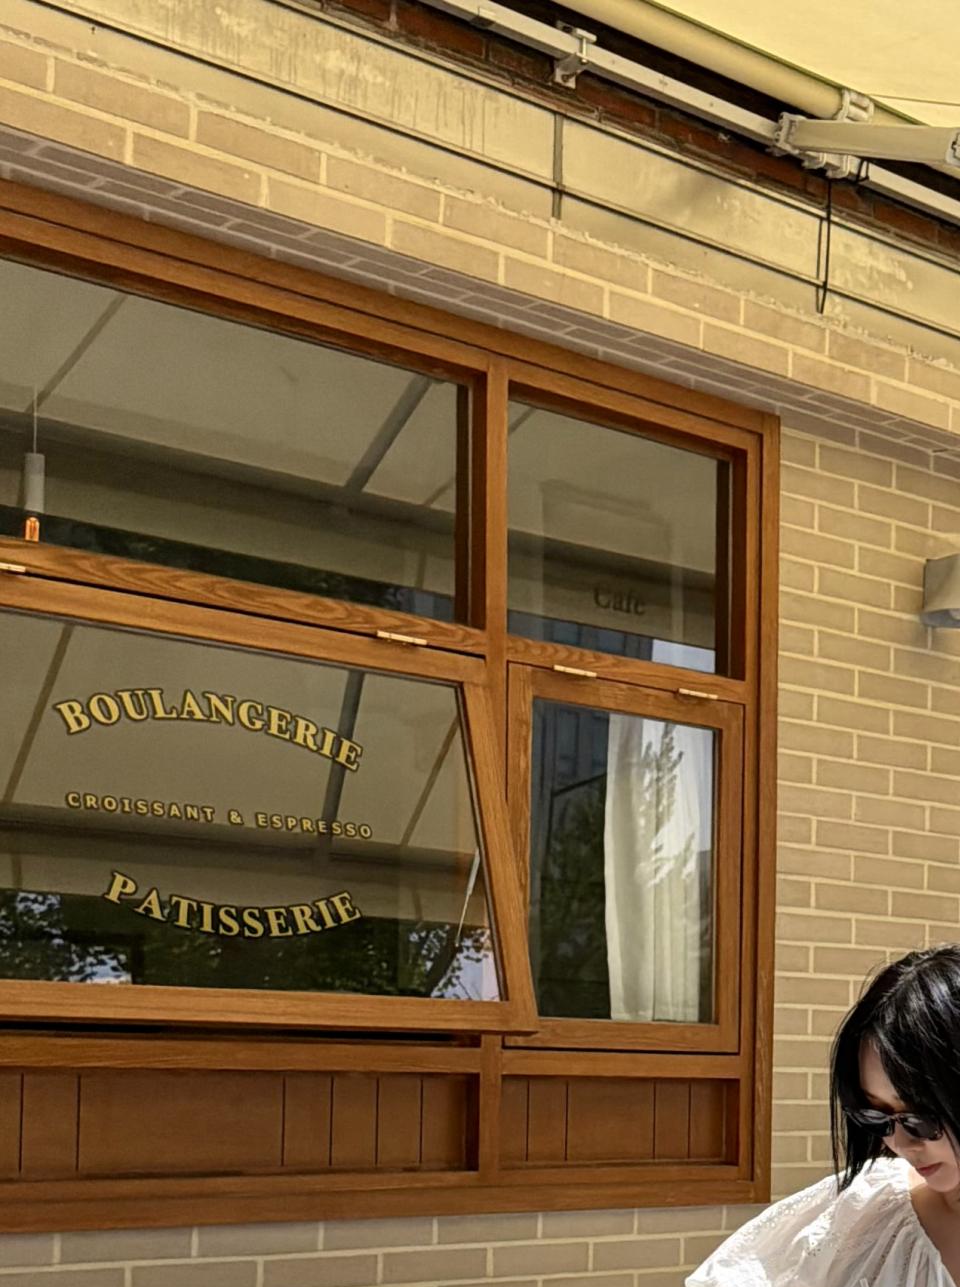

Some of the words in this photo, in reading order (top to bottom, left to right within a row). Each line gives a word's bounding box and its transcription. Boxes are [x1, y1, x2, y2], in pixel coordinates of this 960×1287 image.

[55, 688, 364, 772] BOULANGERIE
[66, 792, 216, 823] CROISSANT
[228, 810, 244, 825] &
[257, 812, 373, 839] ESPRESSO
[104, 871, 363, 938] PATISSERIE
